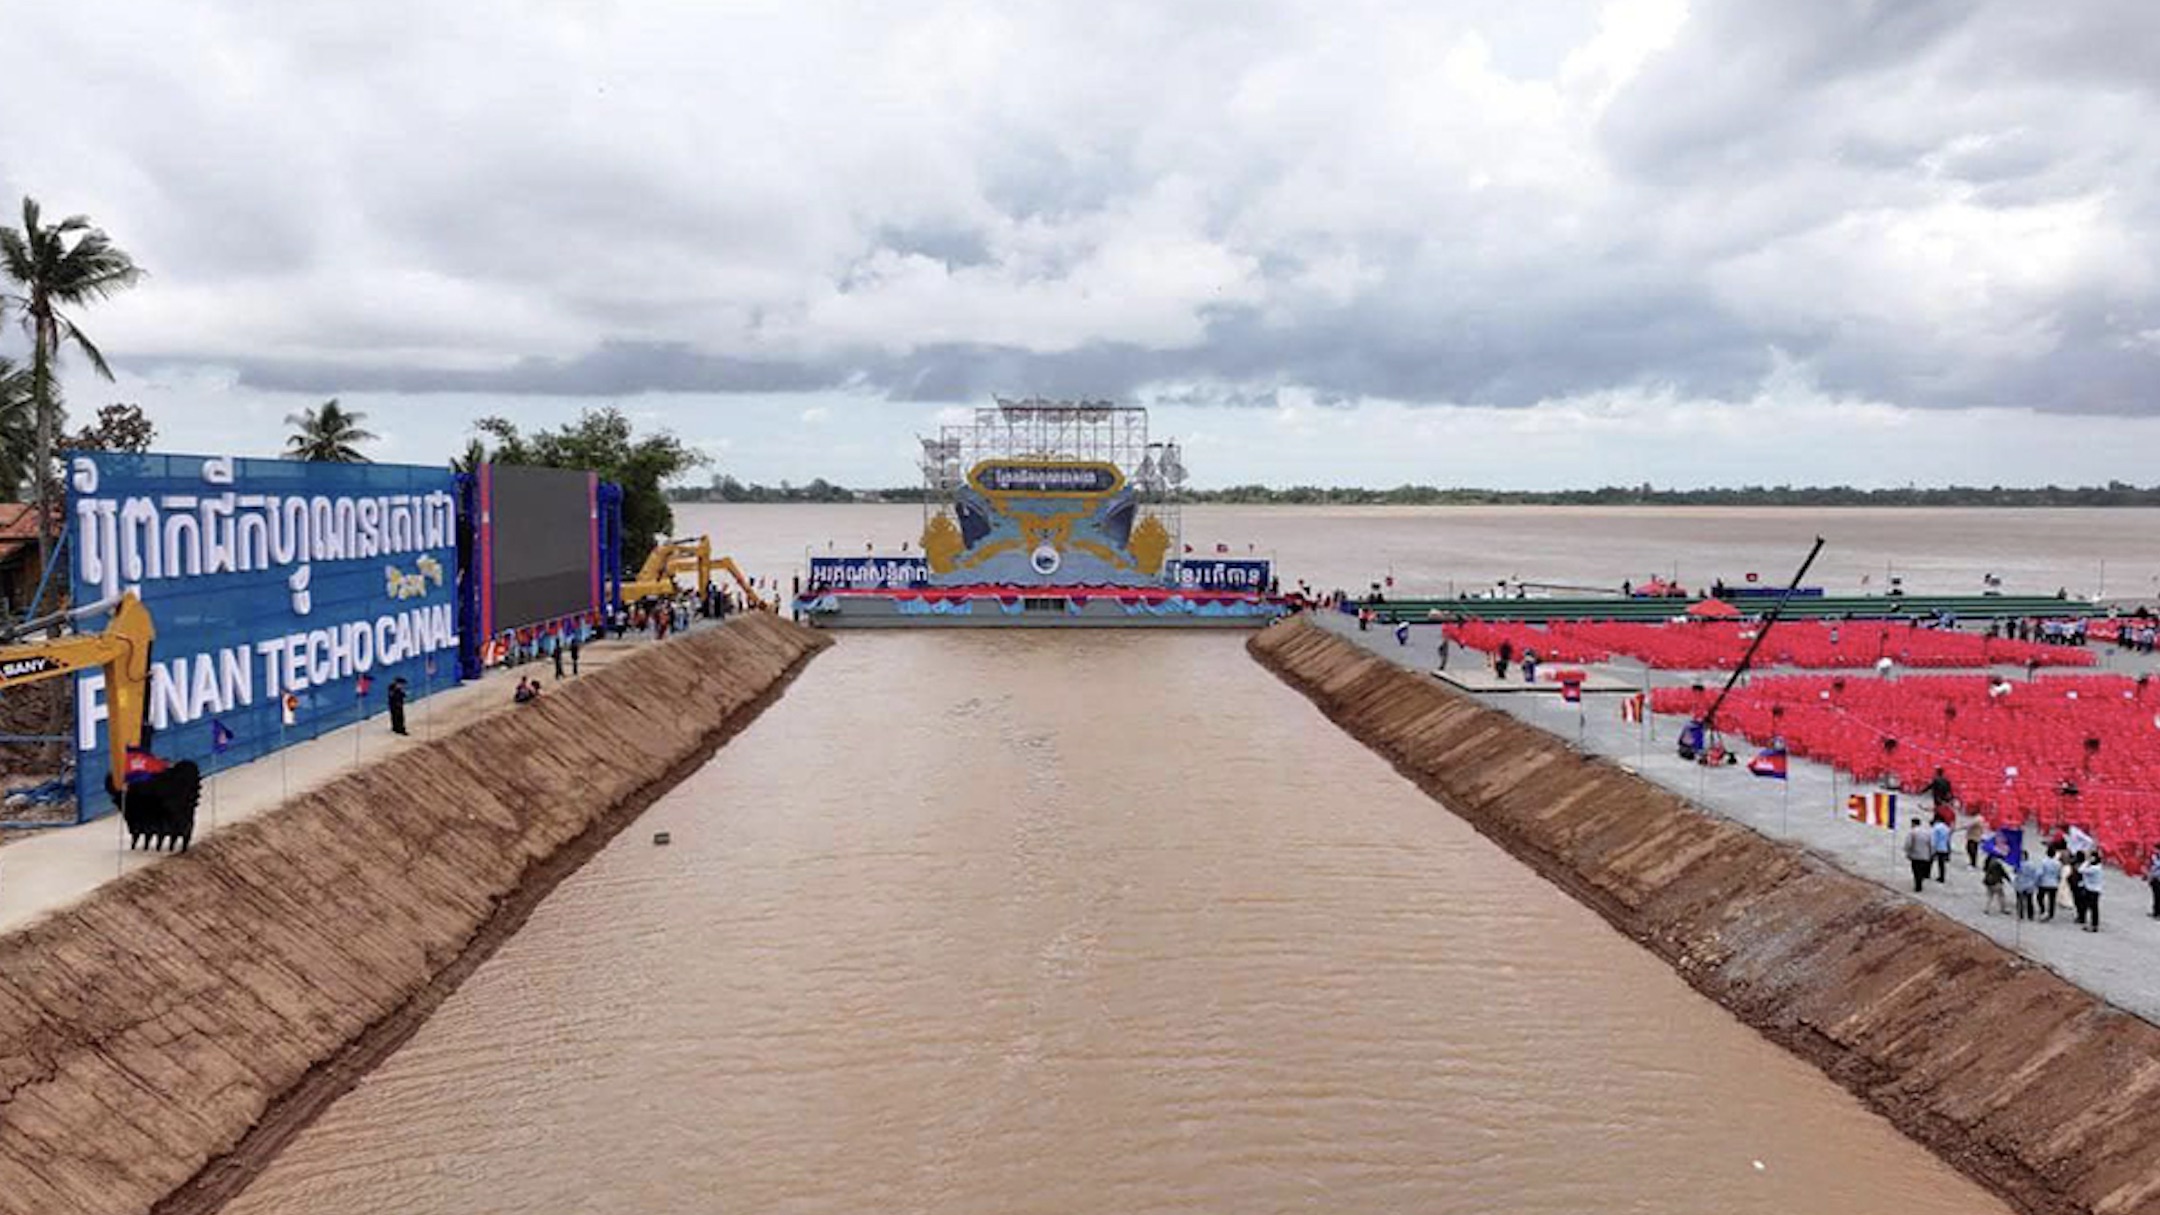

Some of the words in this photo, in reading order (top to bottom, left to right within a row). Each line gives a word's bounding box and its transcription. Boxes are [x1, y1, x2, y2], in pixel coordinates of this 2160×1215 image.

[78, 644, 252, 750] FNAN
[257, 620, 373, 697] TECHO
[374, 603, 460, 666] CANAL
